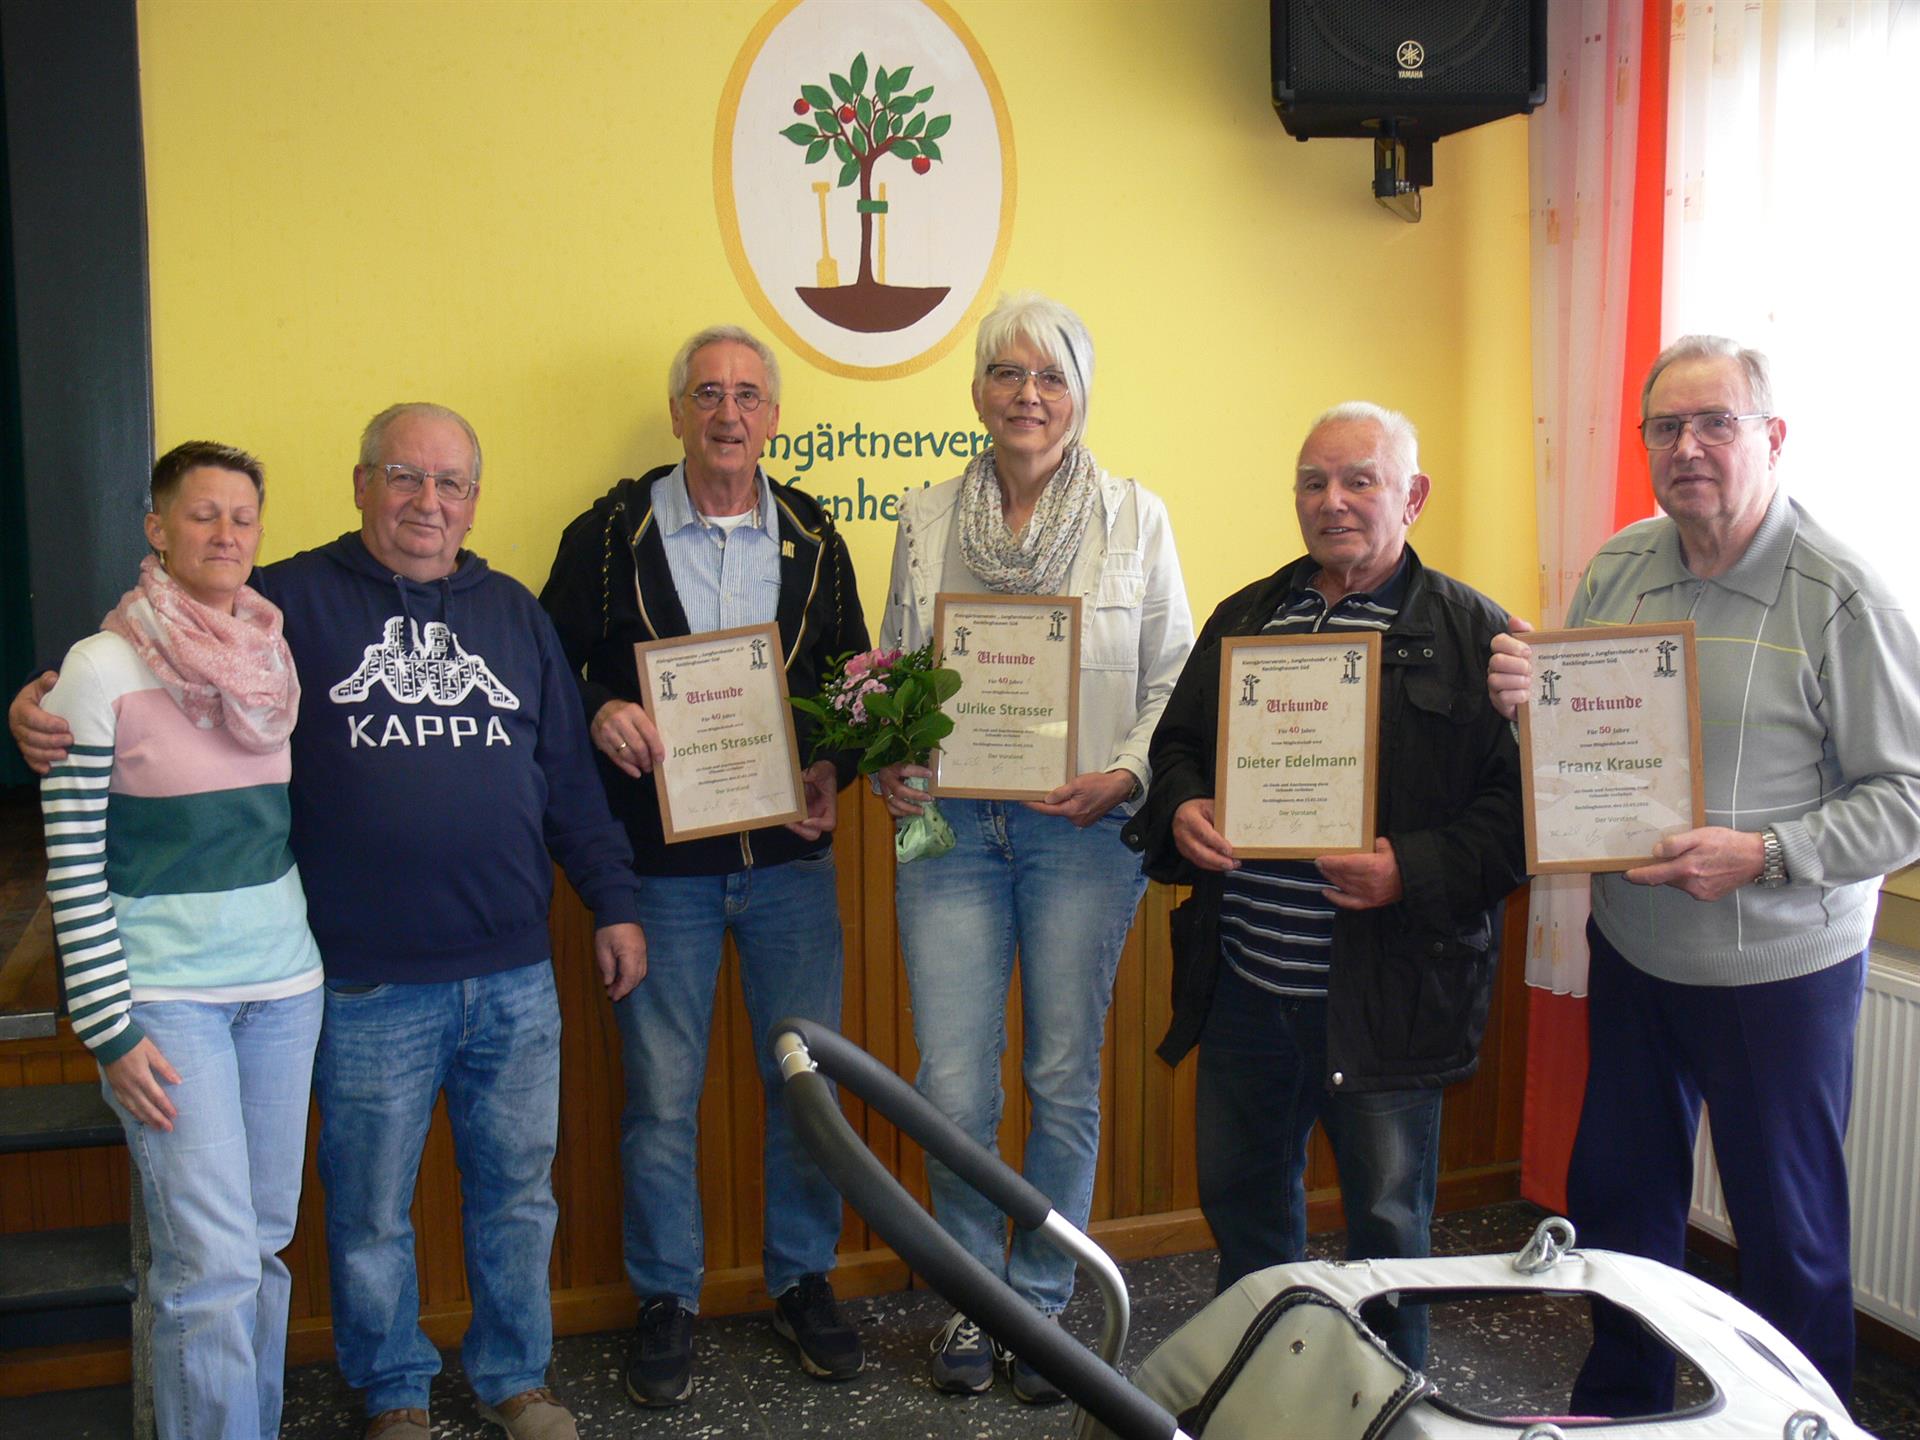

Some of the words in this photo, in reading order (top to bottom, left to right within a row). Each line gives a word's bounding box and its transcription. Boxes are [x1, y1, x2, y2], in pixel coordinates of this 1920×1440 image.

[1398, 70, 1424, 79] YAMAHA
[977, 649, 1036, 665] Urkunde
[998, 676, 1009, 685] 40
[686, 686, 744, 705] Urkunde
[956, 702, 997, 715] Ulrike
[999, 703, 1054, 717] Strasser
[1266, 698, 1329, 713] Urkunde
[1570, 696, 1643, 713] Urkunde
[711, 712, 721, 720] 40
[347, 713, 512, 749] KAPPA
[1289, 725, 1300, 735] 40
[1599, 725, 1611, 735] 50
[672, 742, 718, 758] Jochen
[721, 733, 774, 750] Strasser
[1237, 756, 1281, 769] Dieter
[1285, 754, 1357, 768] Edelmann
[1558, 760, 1602, 774] Franz
[1607, 757, 1663, 772] Krause
